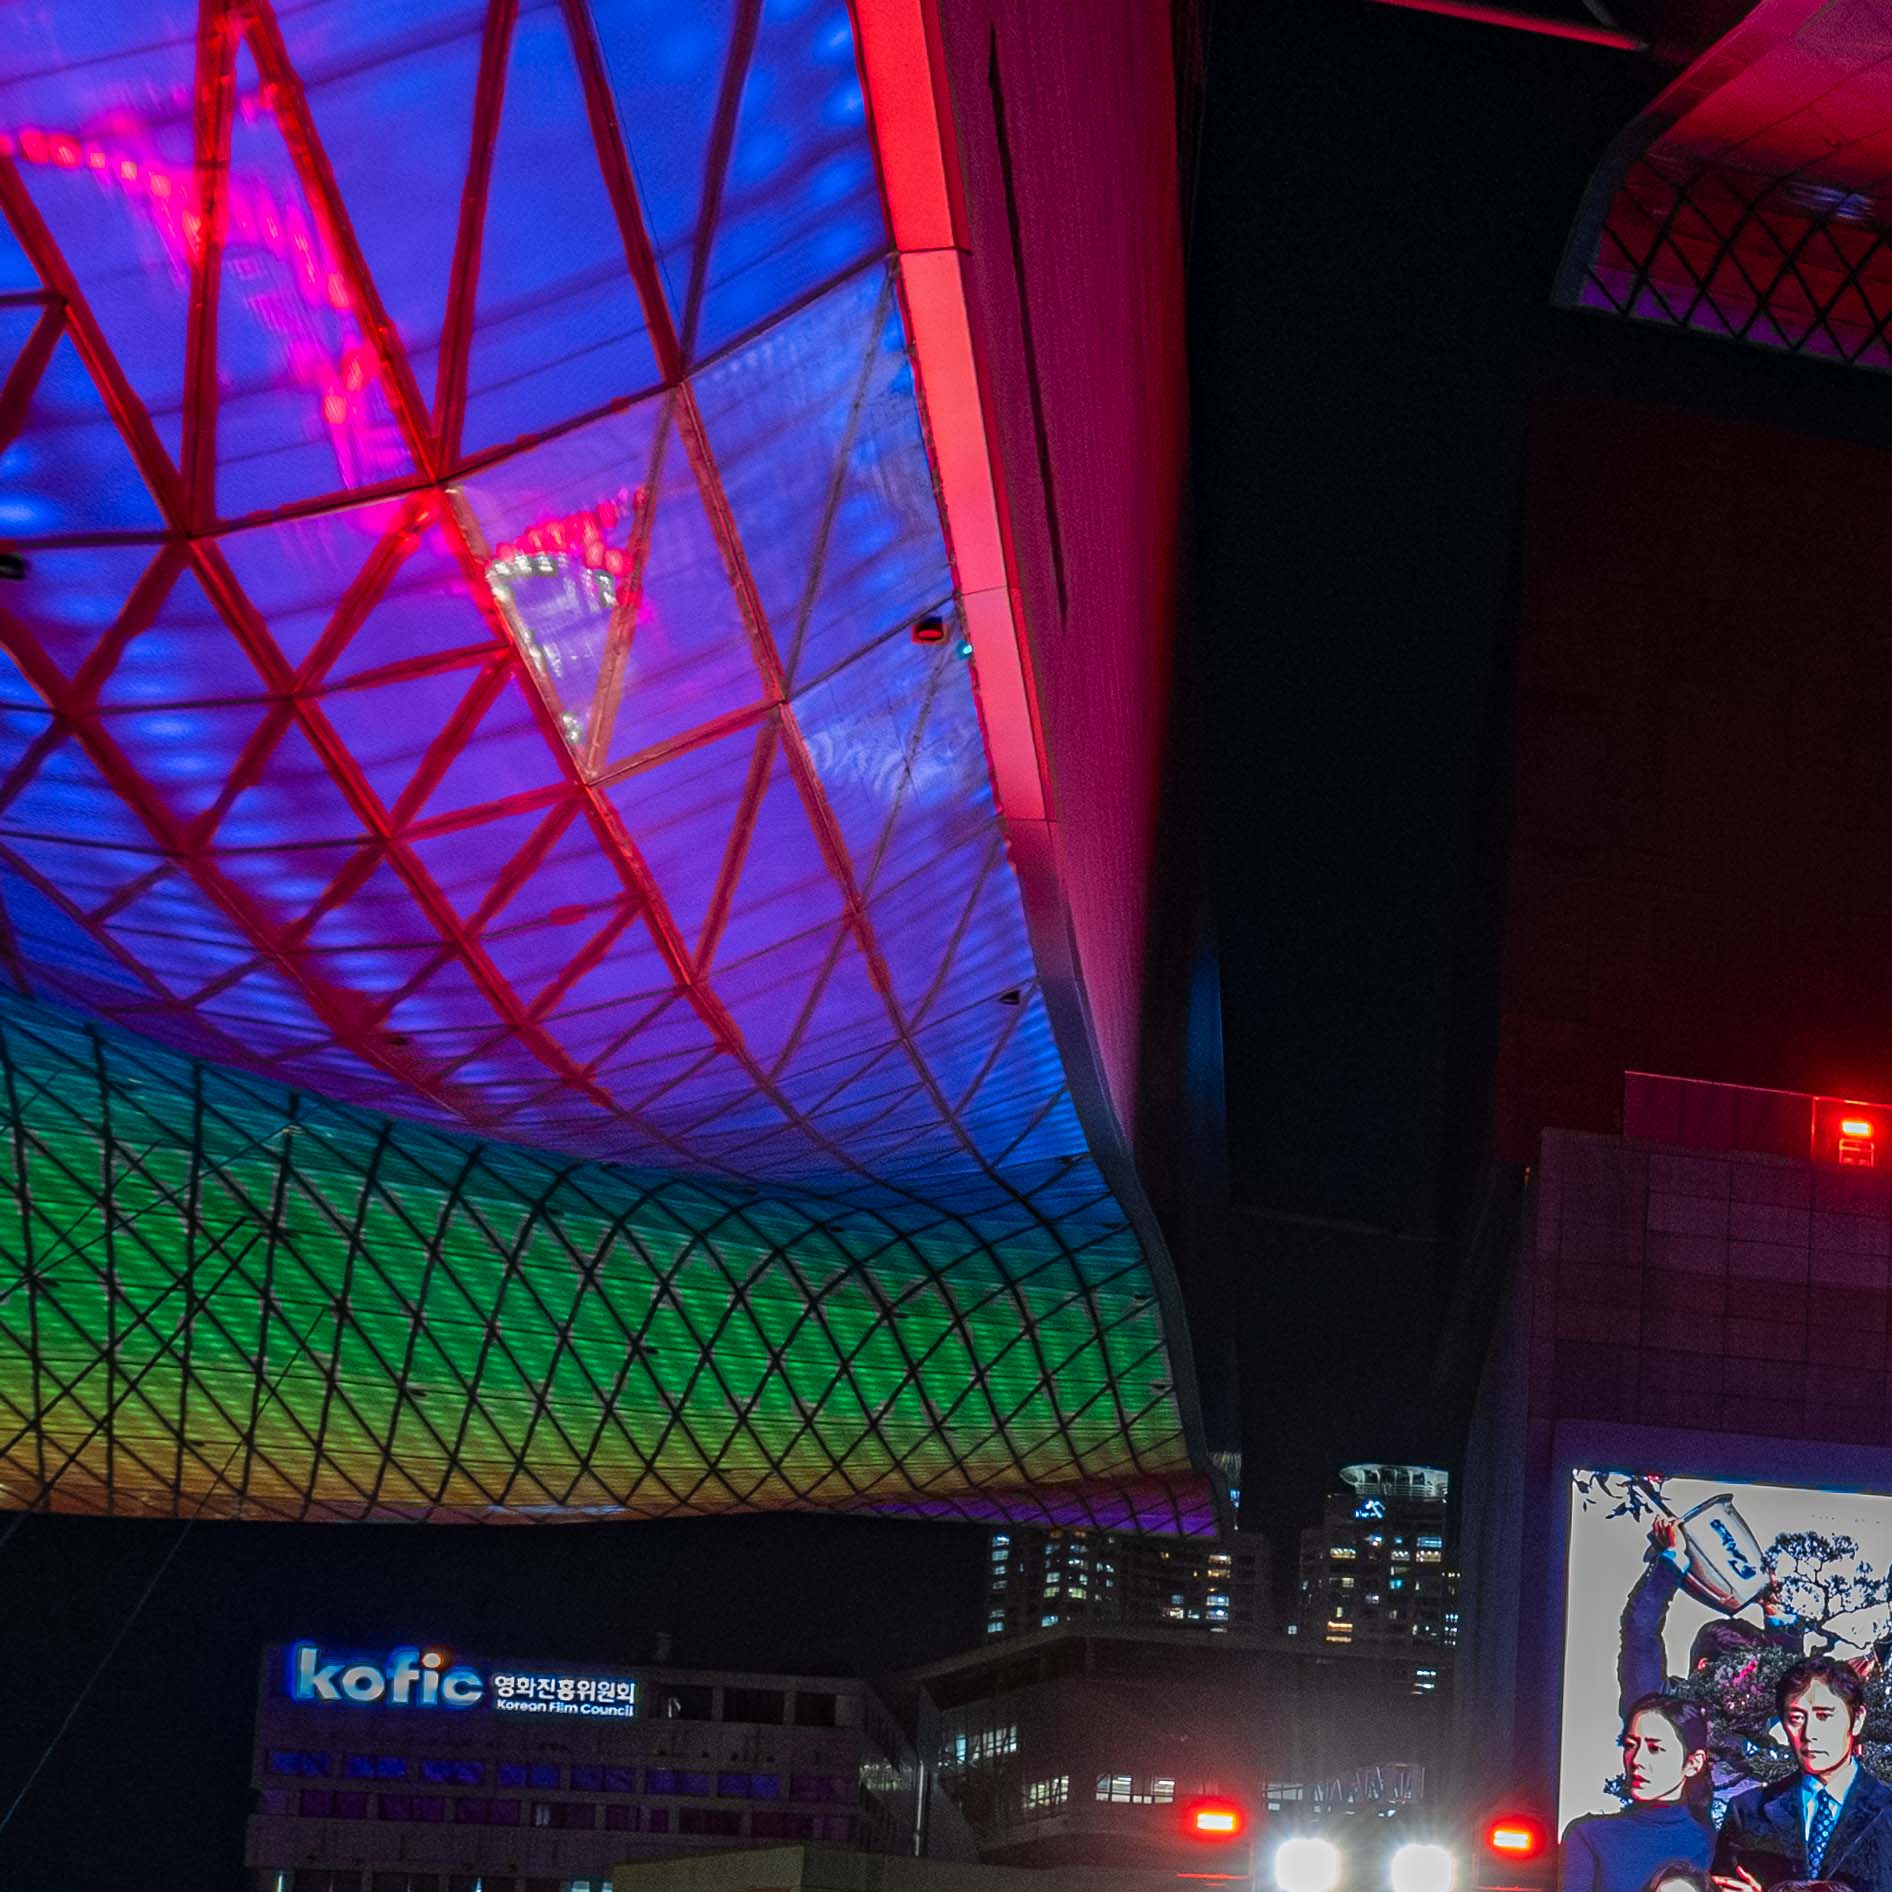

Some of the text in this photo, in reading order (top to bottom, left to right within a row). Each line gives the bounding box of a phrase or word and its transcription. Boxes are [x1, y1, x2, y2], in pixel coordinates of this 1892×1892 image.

[298, 1648, 484, 1705] kofic
[494, 1676, 636, 1704] 영화진흥위원회
[497, 1699, 635, 1718] Korean Film Council
